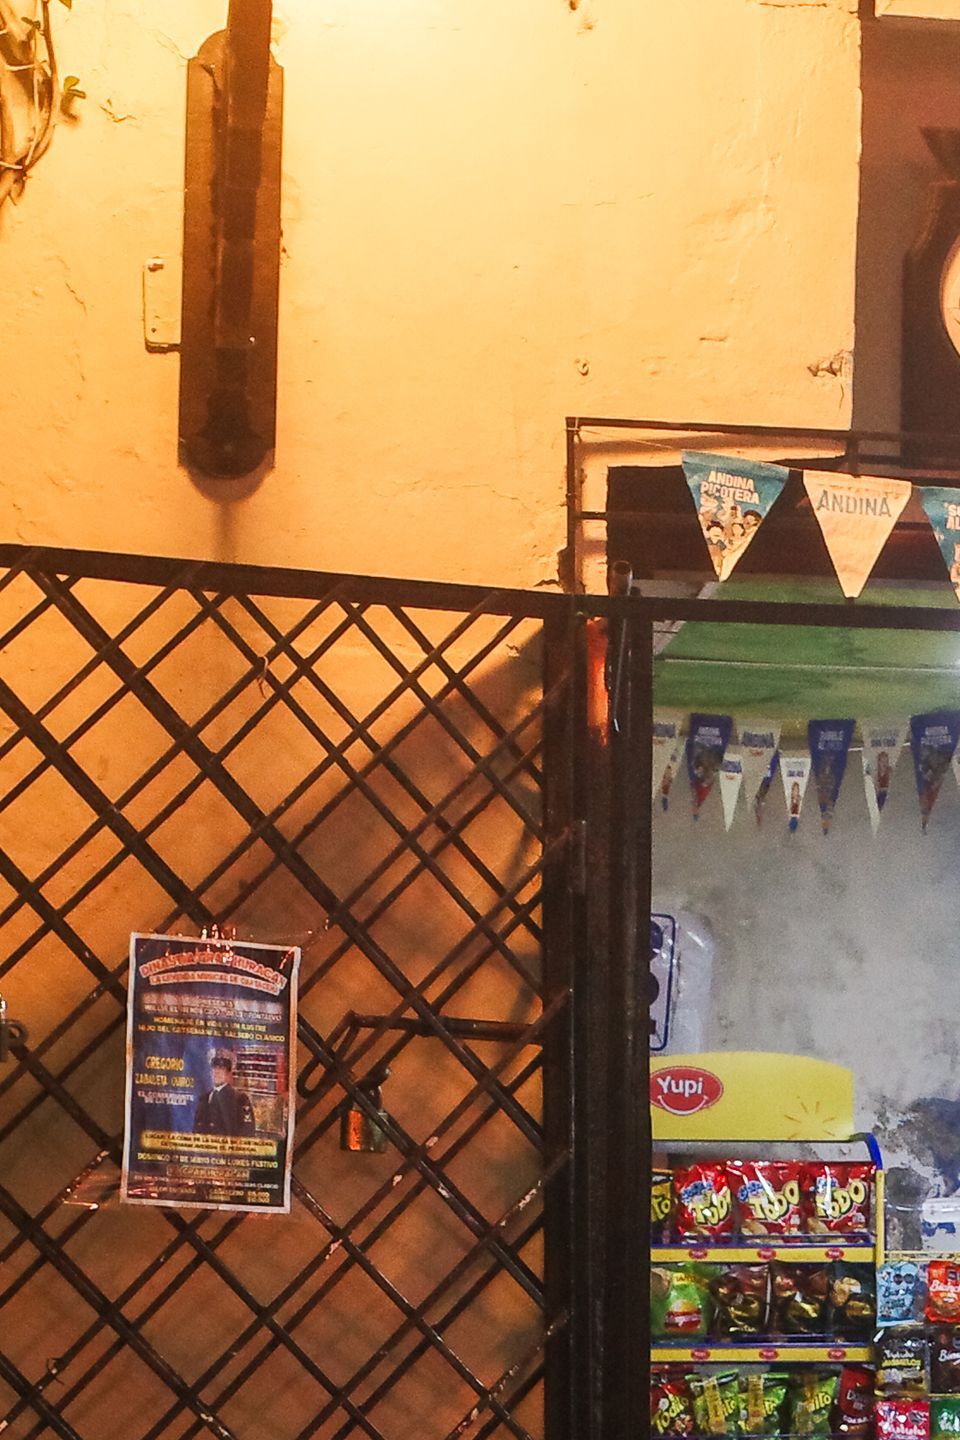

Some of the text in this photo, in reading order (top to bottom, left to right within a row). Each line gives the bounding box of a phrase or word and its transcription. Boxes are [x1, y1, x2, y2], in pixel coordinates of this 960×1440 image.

[700, 481, 759, 504] PICOTERA
[708, 471, 754, 491] ANDINA
[817, 490, 892, 517] ANDINA
[145, 1056, 185, 1071] GREGORIO
[657, 1075, 704, 1098] Yupi
